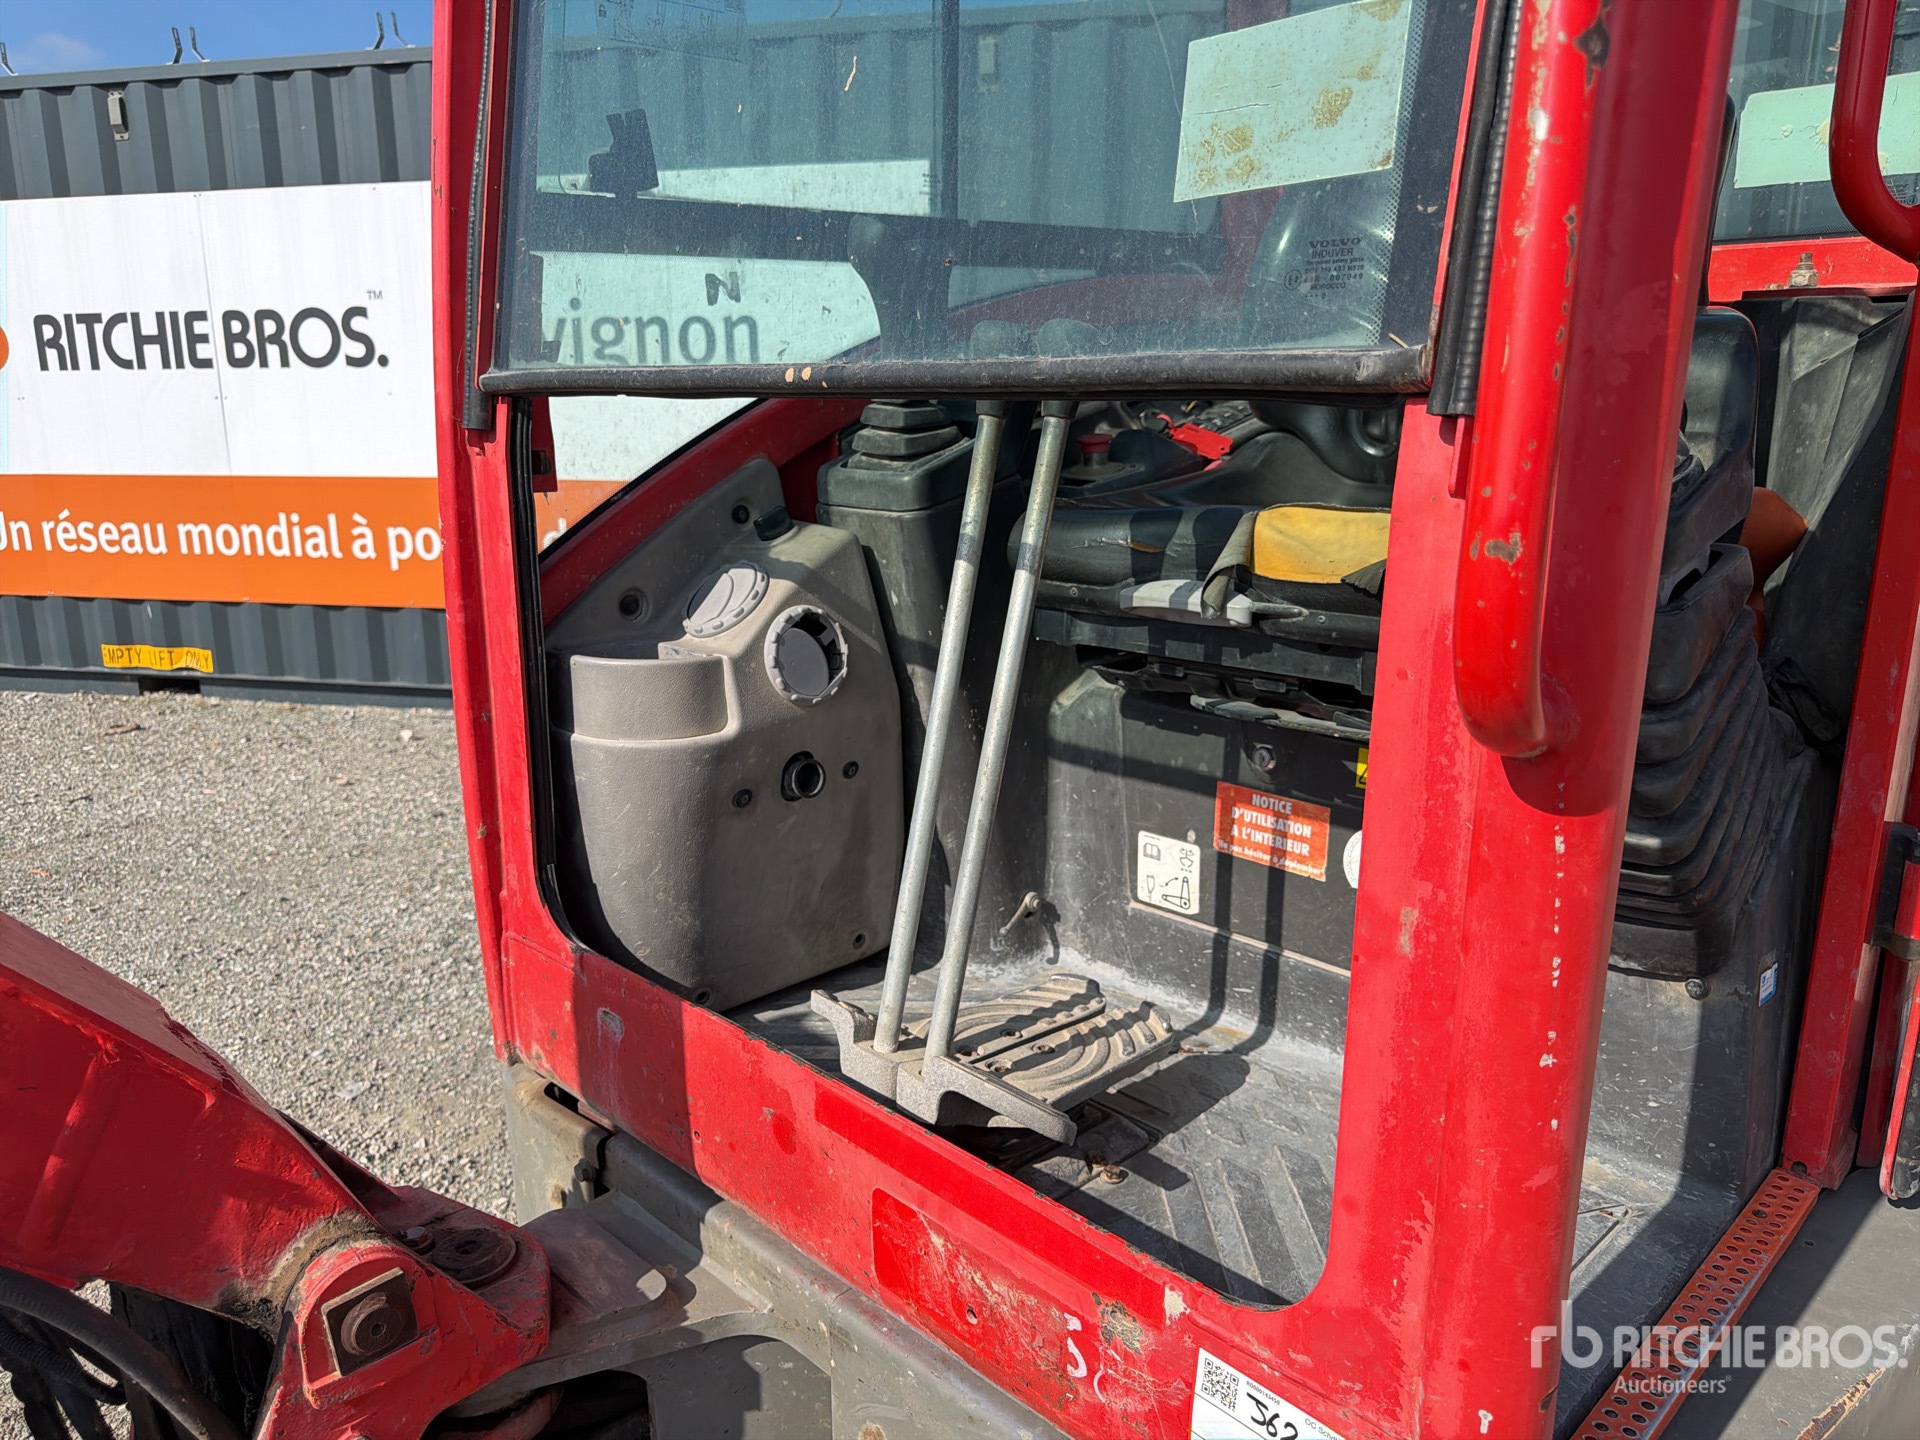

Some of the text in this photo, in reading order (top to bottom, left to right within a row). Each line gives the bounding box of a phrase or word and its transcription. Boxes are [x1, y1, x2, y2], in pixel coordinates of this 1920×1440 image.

[1309, 237, 1362, 248] VOLVO
[1311, 247, 1354, 259] INDUVER
[1309, 282, 1346, 291] MOROCCO
[33, 306, 390, 372] RITCHIE BROS.
[43, 509, 168, 555] réseau
[178, 511, 343, 559] mondial
[352, 512, 377, 559] à
[148, 648, 175, 667] LIFT
[1252, 794, 1292, 815] NOTICE
[1231, 806, 1312, 838] D'UTILISATION
[1241, 826, 1311, 857] L'INTERIEUR
